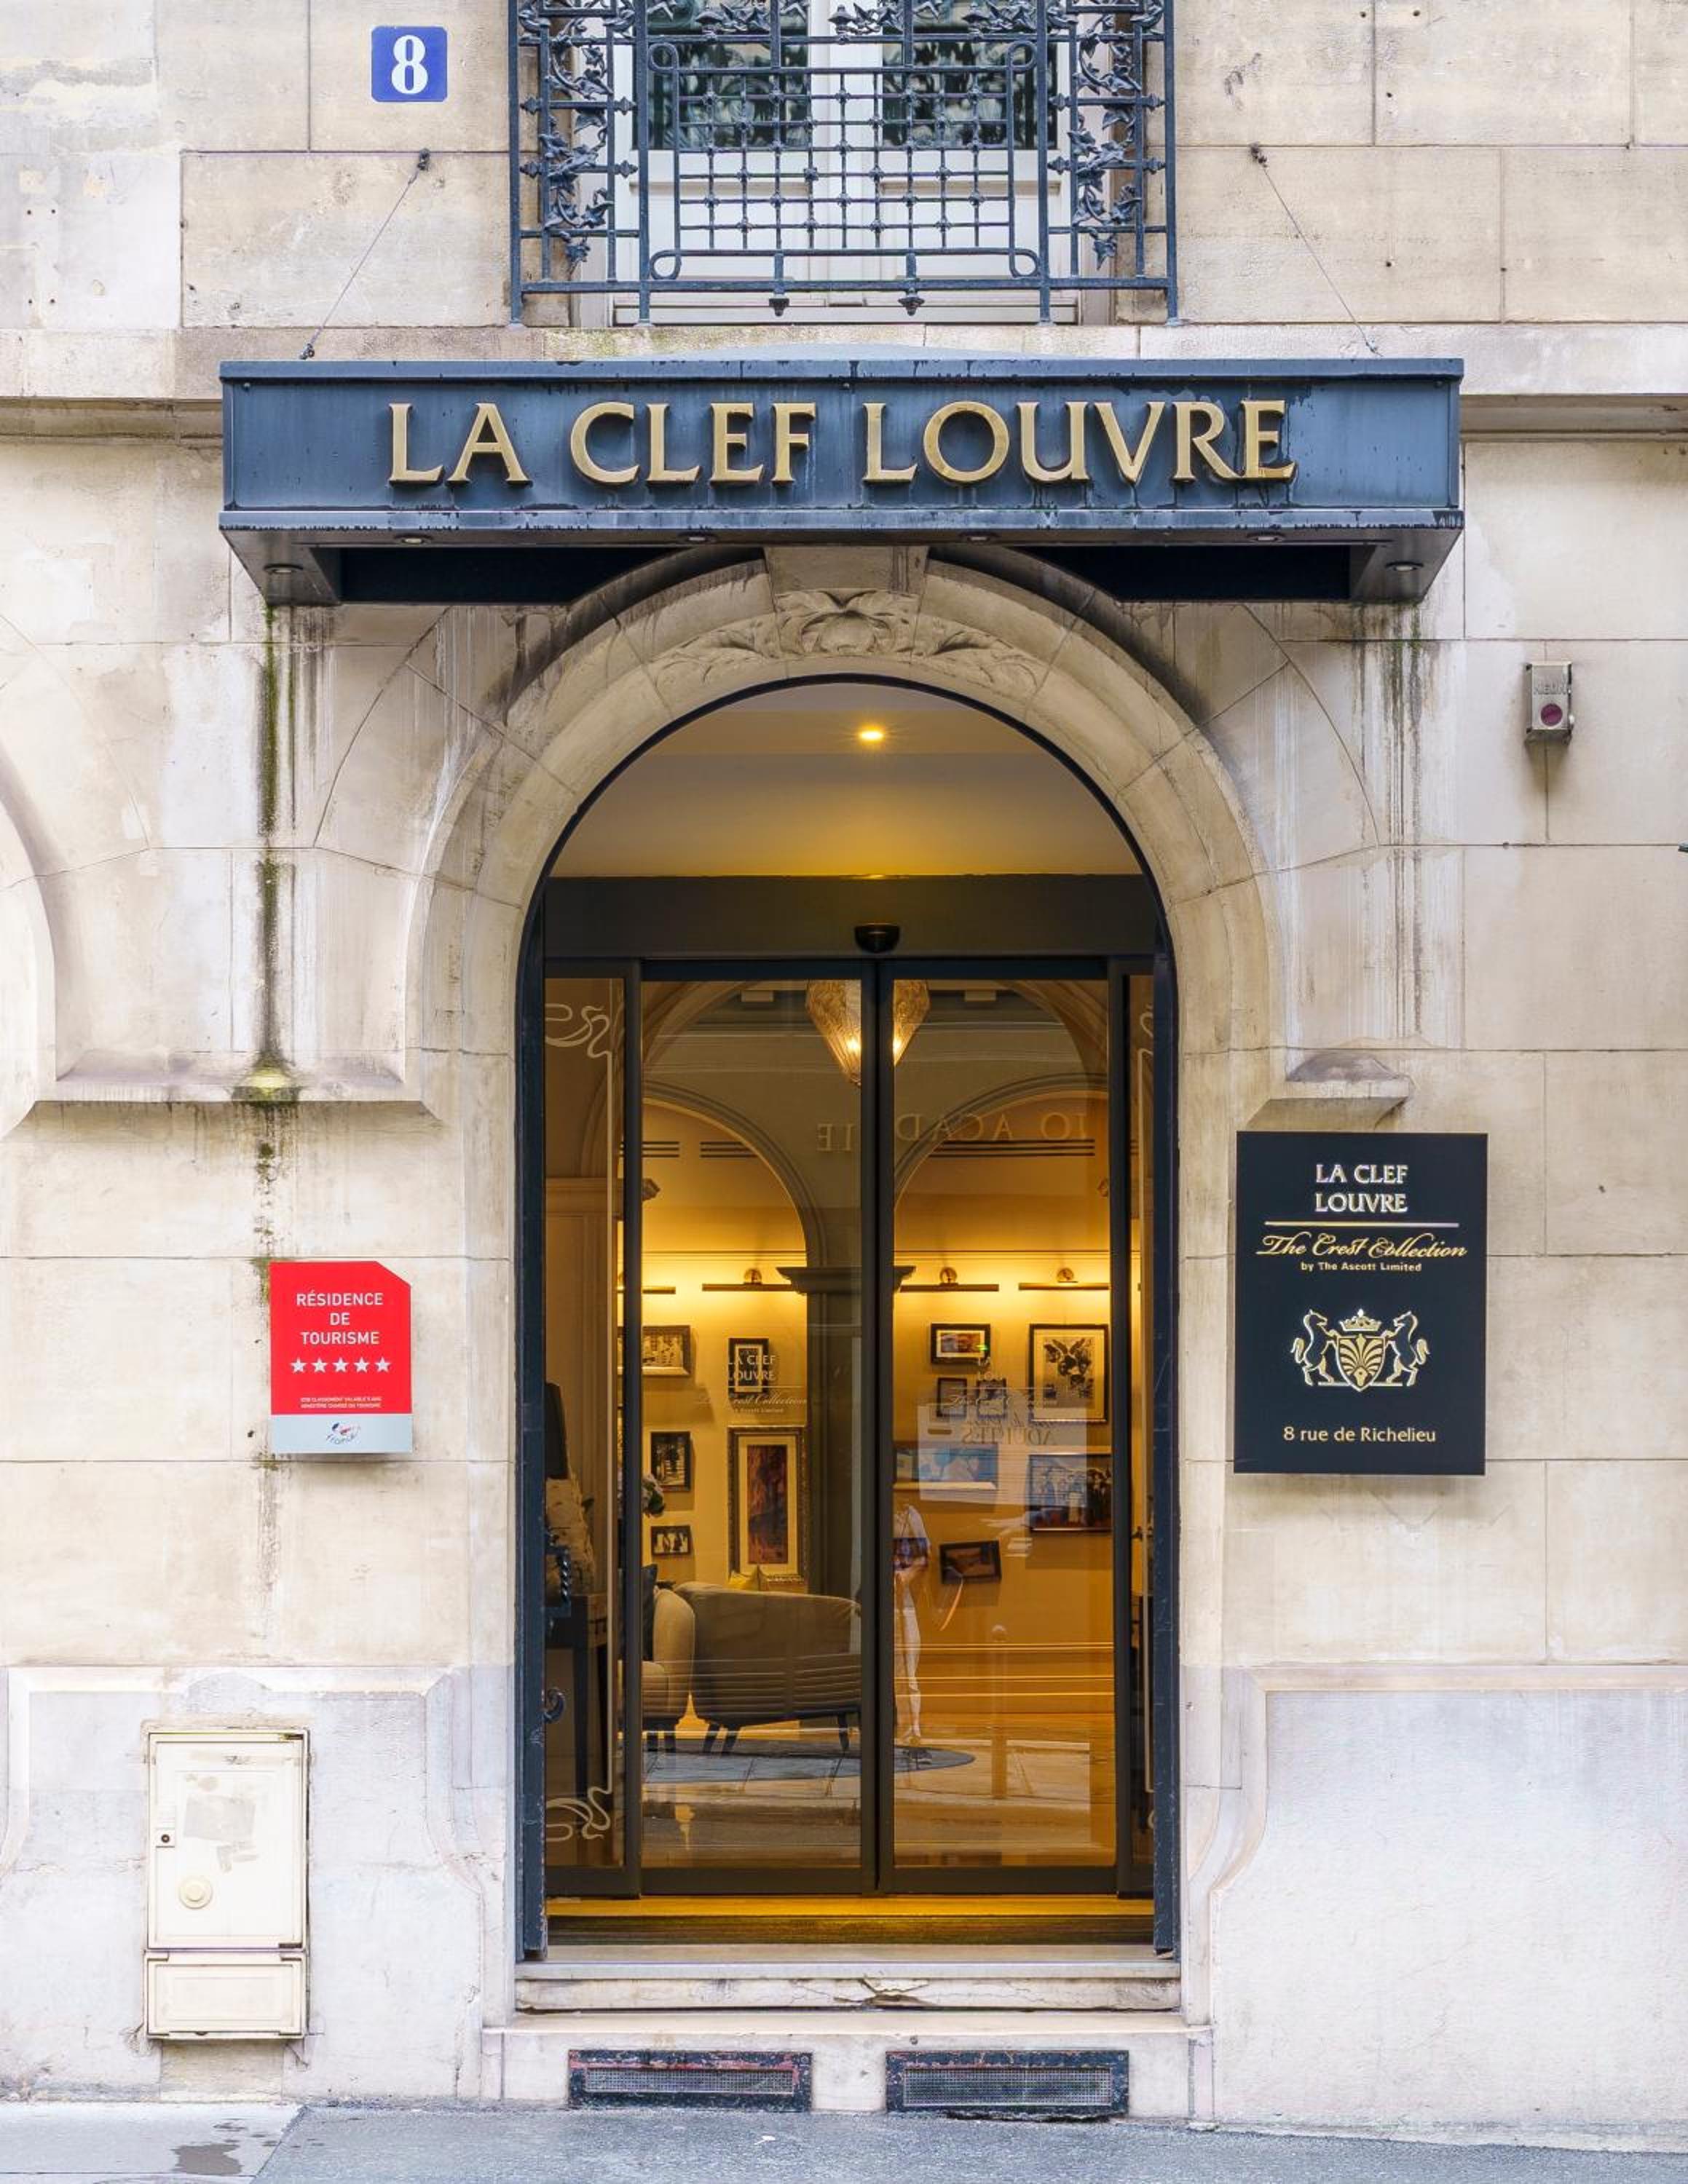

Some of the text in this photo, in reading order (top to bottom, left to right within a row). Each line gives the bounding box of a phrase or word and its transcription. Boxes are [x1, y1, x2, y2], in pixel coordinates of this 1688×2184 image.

[391, 34, 428, 95] 8
[388, 399, 1298, 486] LA CLEF LOUVRE
[1315, 1163, 1408, 1184] LA CLEF
[1314, 1192, 1408, 1213] LOUVRE
[1255, 1231, 1468, 1259] The Crest Collection
[1301, 1262, 1422, 1273] by The Ascott Limited
[296, 1289, 384, 1307] RÉSIDENCE
[329, 1313, 350, 1326] DE
[300, 1331, 380, 1345] TOURISME
[1283, 1425, 1437, 1443] 8 rue de Richelieu
